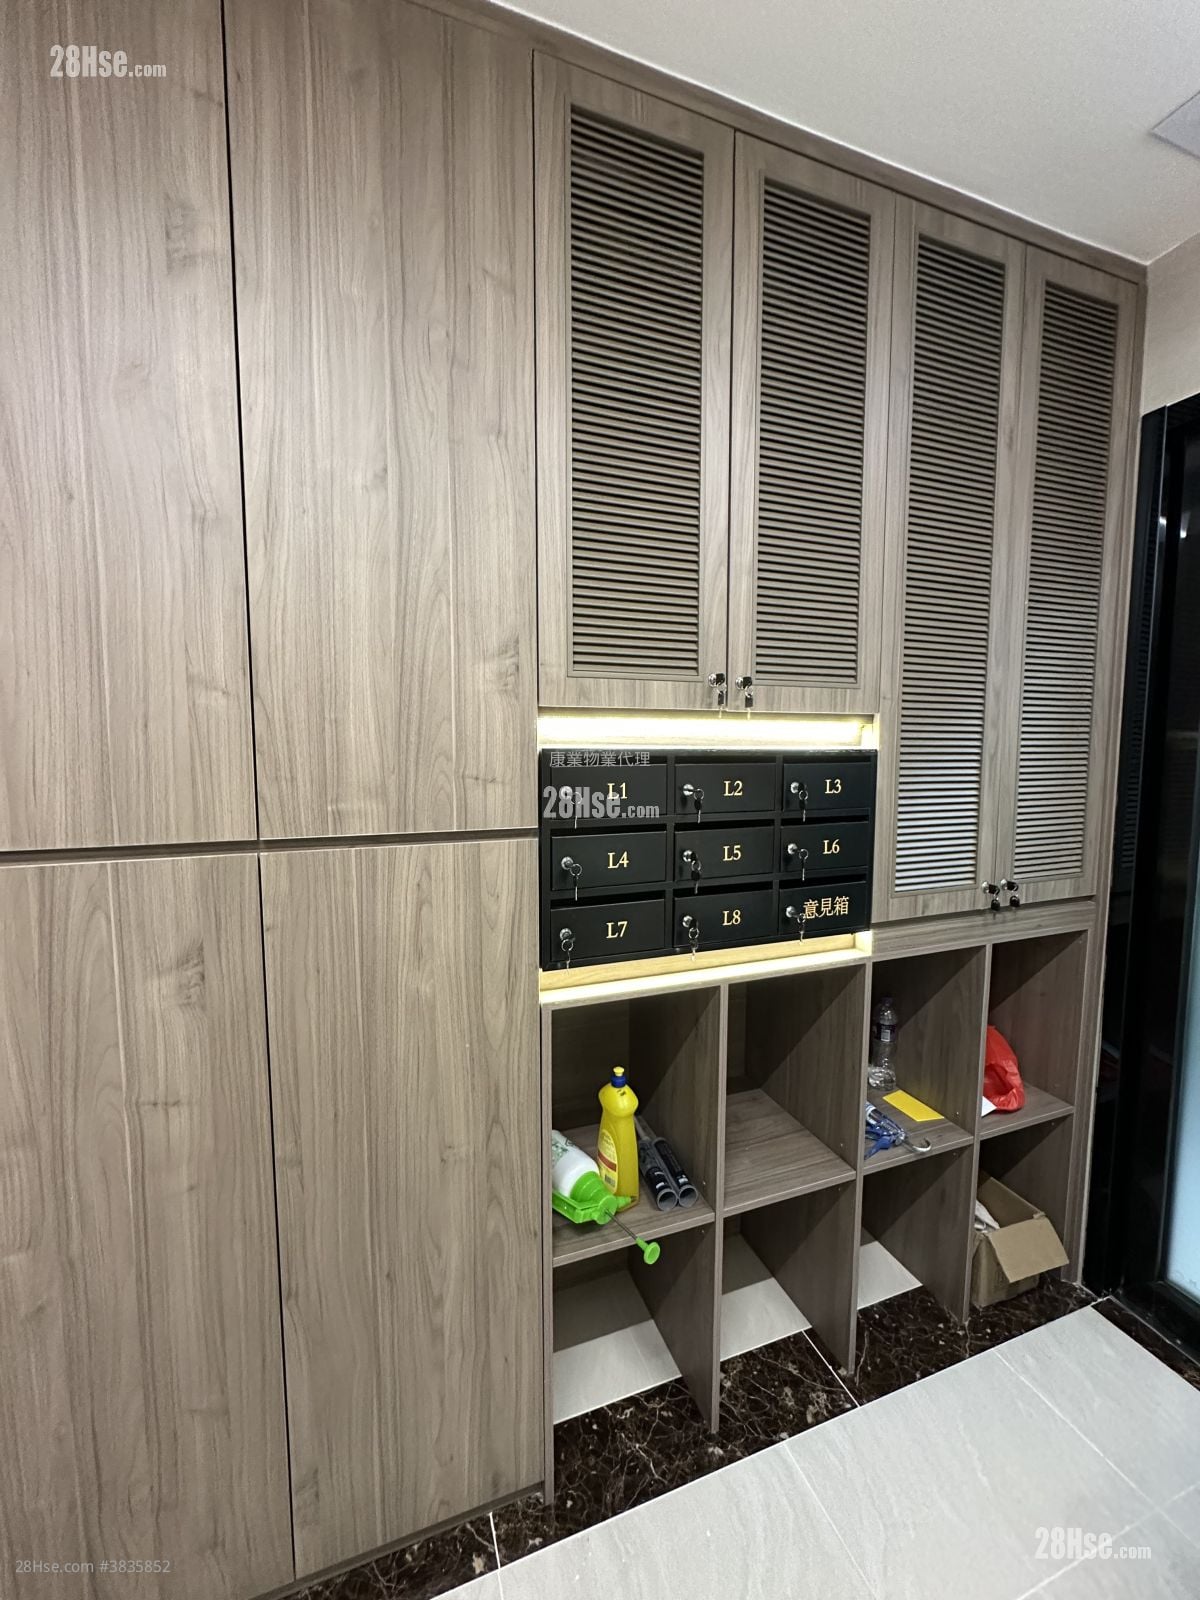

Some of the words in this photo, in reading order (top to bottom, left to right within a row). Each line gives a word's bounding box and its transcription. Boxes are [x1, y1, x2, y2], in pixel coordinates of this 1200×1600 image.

[607, 782, 628, 800] L1
[723, 780, 743, 797] L2
[824, 778, 842, 794] L3
[722, 844, 742, 862] L5
[823, 839, 840, 855] L6
[607, 851, 630, 869] L4
[803, 896, 850, 919] 意見箱
[722, 909, 741, 926] L8
[605, 921, 628, 939] L7
